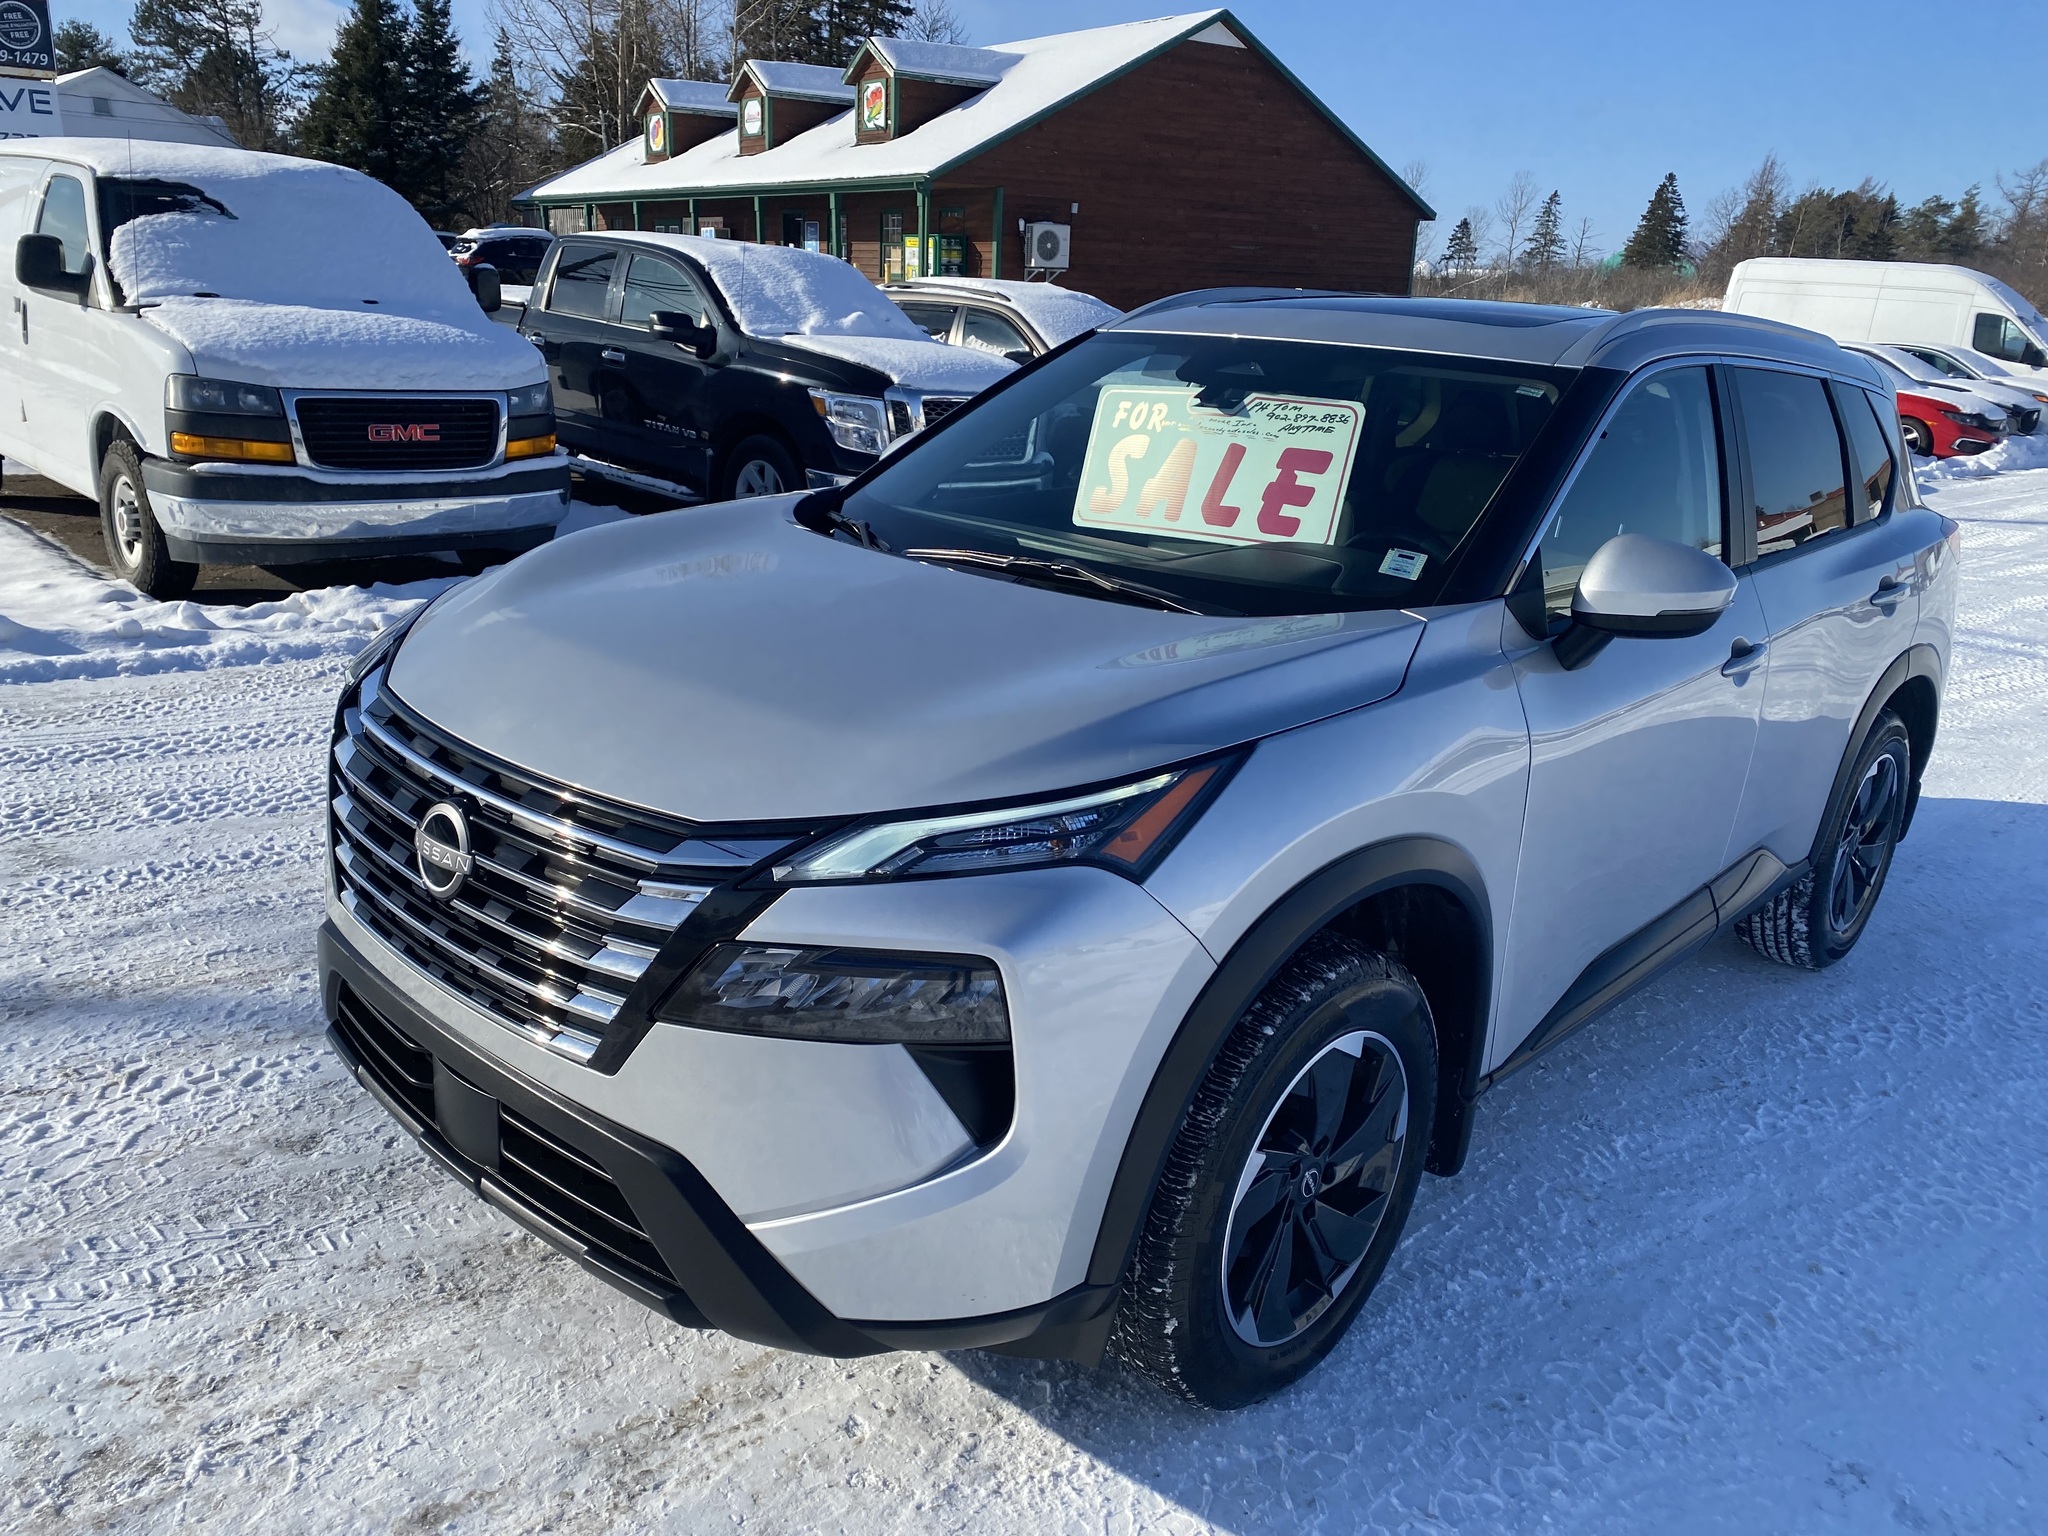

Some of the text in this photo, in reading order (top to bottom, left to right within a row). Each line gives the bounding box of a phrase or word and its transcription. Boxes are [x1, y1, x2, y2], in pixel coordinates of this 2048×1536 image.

[3, 12, 22, 20] FREE
[10, 31, 30, 39] FREE
[1248, 401, 1271, 414] PH
[1112, 401, 1169, 434] FOR
[367, 423, 441, 442] GMC
[643, 418, 681, 435] TITAN
[1277, 422, 1337, 435] ANYTIME
[1089, 433, 1334, 538] SALE
